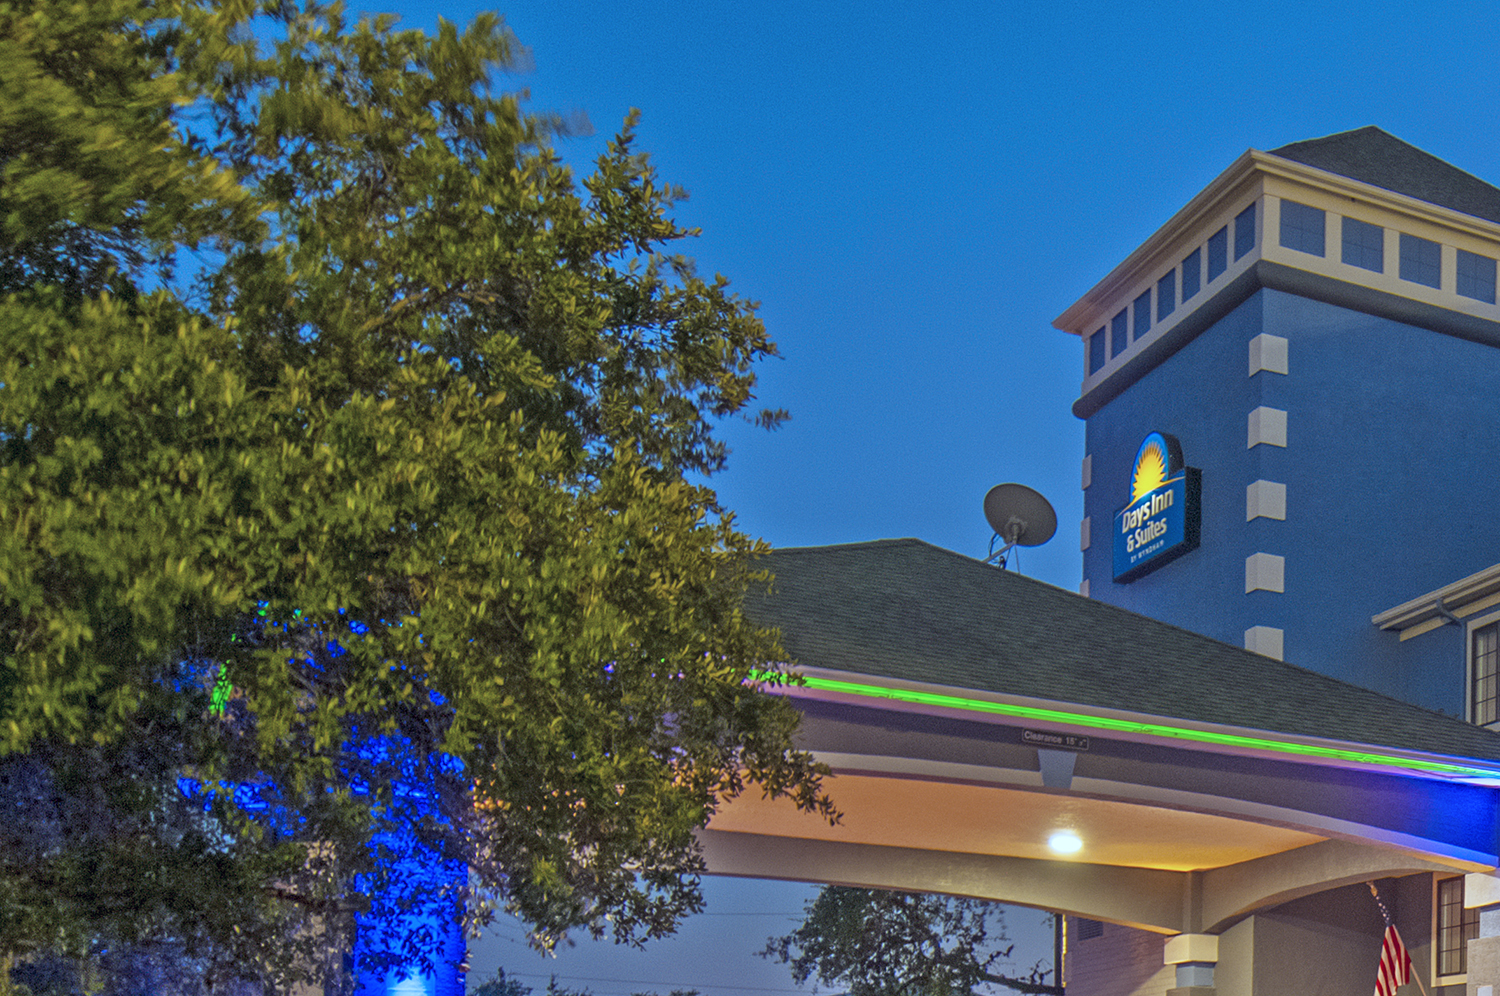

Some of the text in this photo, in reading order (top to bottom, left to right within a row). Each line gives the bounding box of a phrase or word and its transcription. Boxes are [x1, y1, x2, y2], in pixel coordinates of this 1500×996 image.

[1122, 489, 1174, 534] Days Inn
[1127, 517, 1167, 553] & Suites
